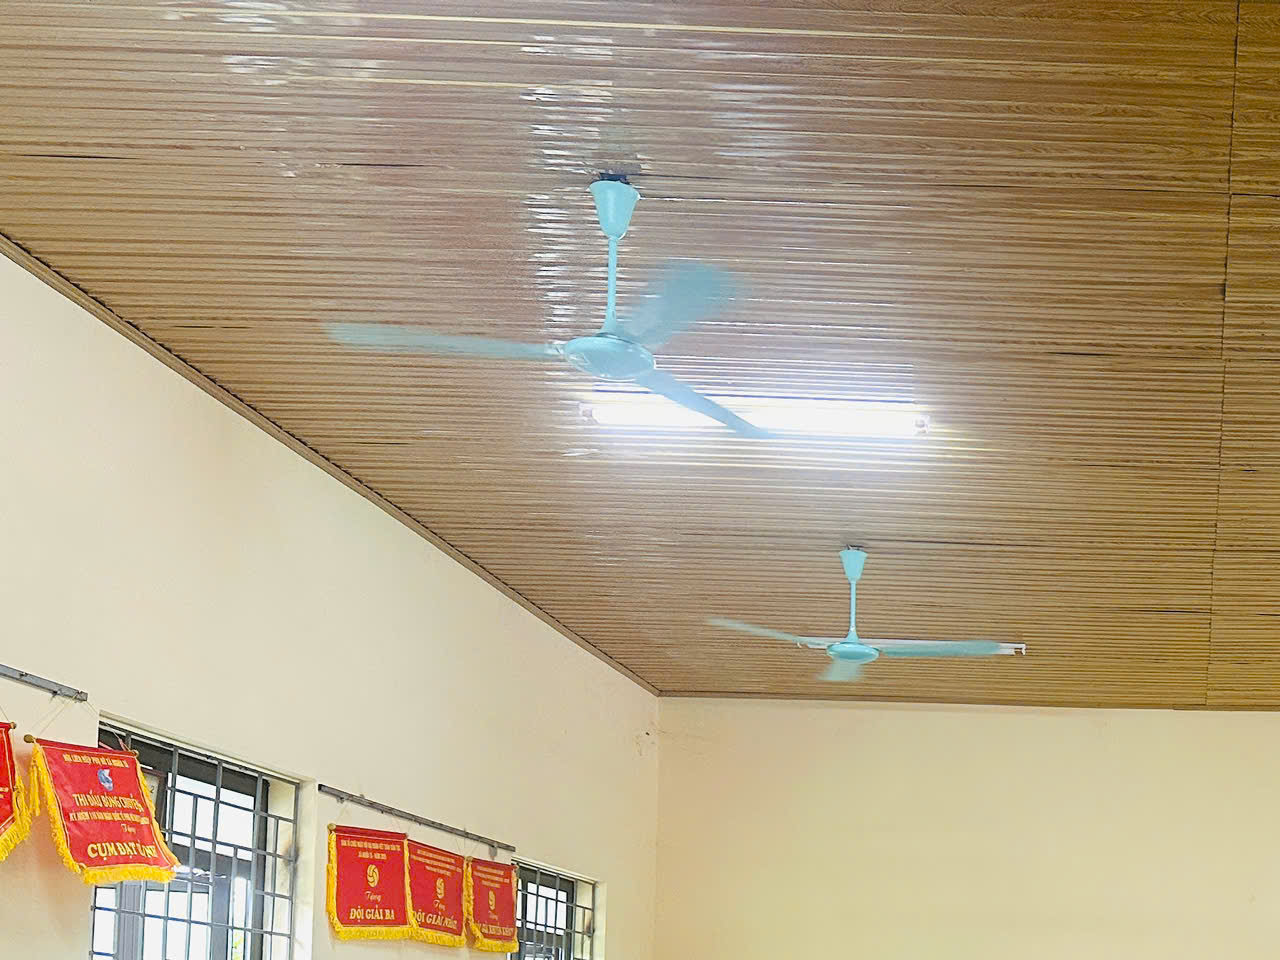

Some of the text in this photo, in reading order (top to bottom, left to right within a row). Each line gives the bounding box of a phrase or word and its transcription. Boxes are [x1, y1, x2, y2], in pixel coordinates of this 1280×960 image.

[87, 842, 118, 860] CỤM
[349, 904, 395, 922] ĐỘI GIẢI BA
